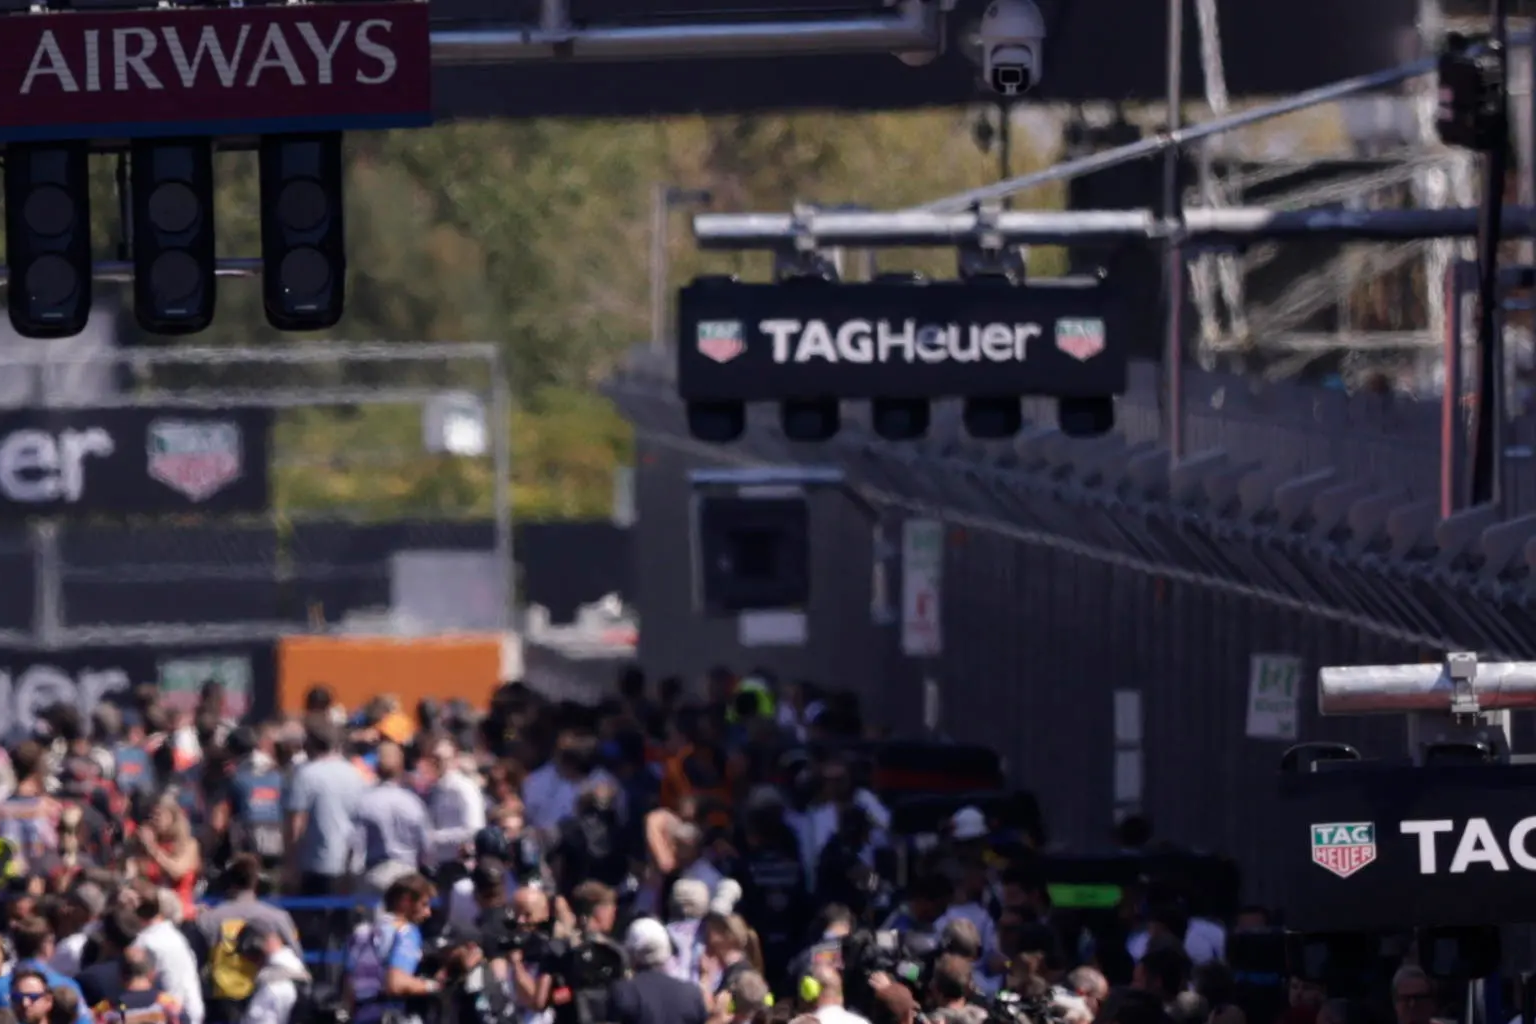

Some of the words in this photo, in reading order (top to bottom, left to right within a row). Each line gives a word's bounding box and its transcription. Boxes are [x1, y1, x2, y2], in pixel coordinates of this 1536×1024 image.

[19, 18, 398, 95] AIRWAYS
[1316, 826, 1369, 844] TAG
[1316, 847, 1373, 872] HEUER
